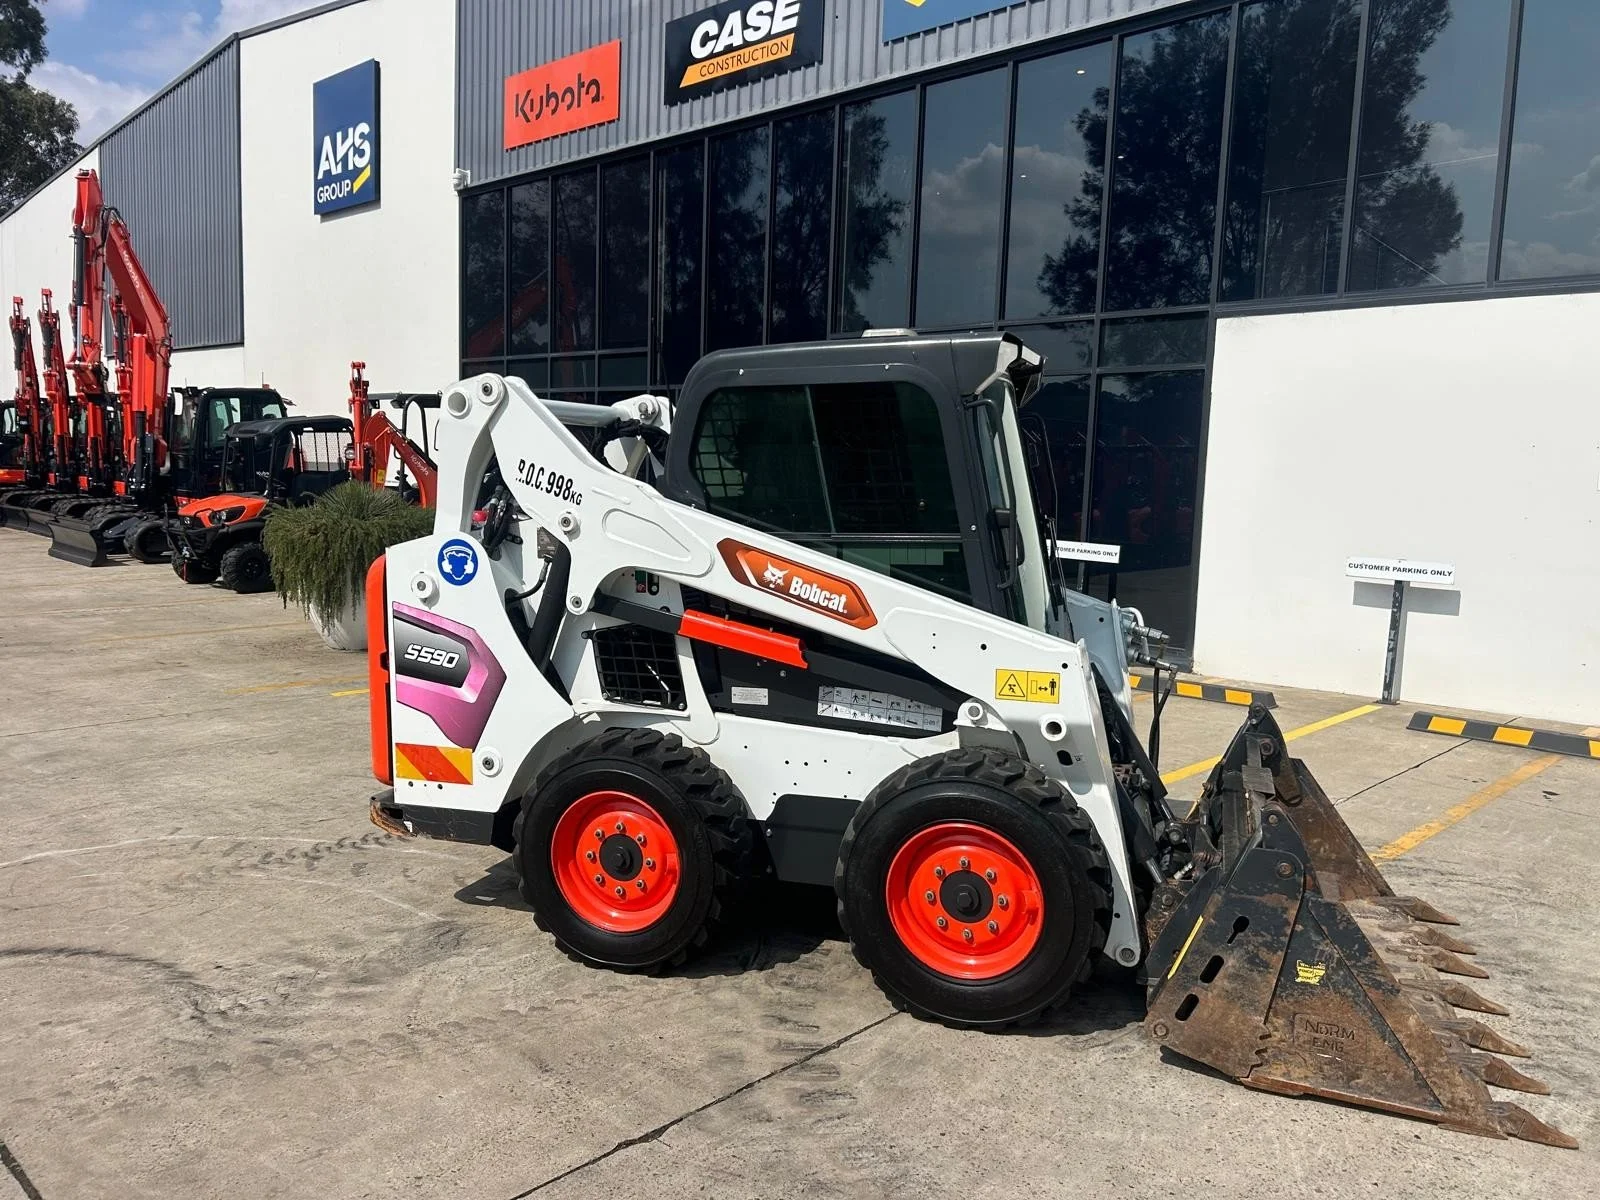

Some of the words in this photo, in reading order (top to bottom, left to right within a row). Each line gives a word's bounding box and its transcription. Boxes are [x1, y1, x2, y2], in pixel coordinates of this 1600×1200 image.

[690, 0, 801, 59] CASE
[699, 39, 789, 78] CONSTRUCTION
[515, 72, 601, 123] Kubota
[317, 122, 371, 180] AHS
[317, 179, 352, 204] GROUP
[1348, 562, 1391, 572] CUSTOMER
[1392, 566, 1429, 575] PARKING
[1430, 569, 1453, 577] ONLY
[788, 575, 847, 613] Bobcat
[404, 643, 460, 669] S590
